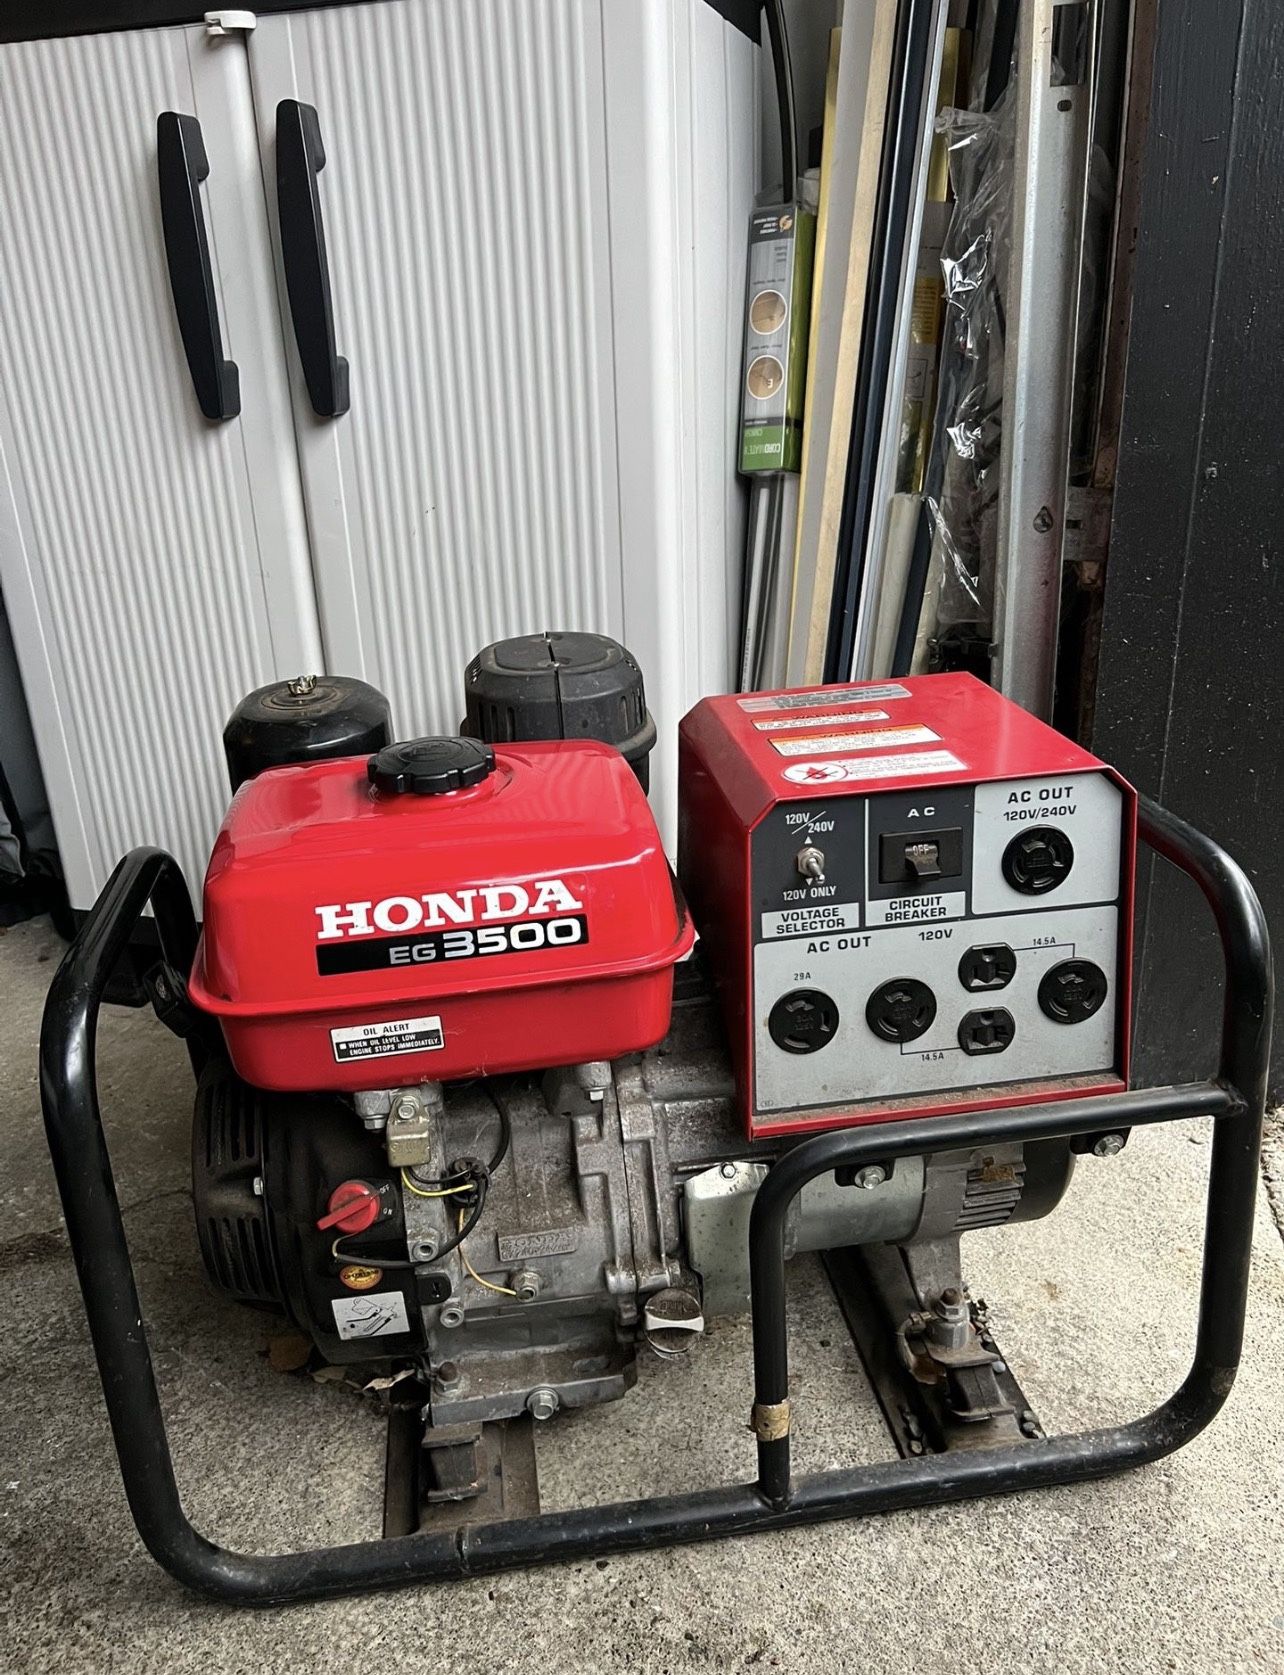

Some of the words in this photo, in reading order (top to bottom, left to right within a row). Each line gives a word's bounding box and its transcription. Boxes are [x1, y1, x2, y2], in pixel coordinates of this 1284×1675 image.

[1007, 791, 1031, 804] AC
[1039, 786, 1074, 801] OUT
[907, 806, 936, 818] AC
[1003, 805, 1077, 821] 120V/240V
[912, 844, 929, 856] OFF
[783, 889, 807, 901] 120V
[810, 885, 837, 898] ONLY
[314, 879, 584, 940] HONDA
[889, 896, 943, 911] CIRCUIT
[781, 907, 840, 922] VOLTAGE
[885, 907, 946, 922] BREAKER
[776, 918, 845, 935] SELECTOR
[388, 942, 436, 965] EG
[442, 917, 582, 958] 3500
[918, 929, 953, 941] 120V
[1033, 936, 1056, 946] 14.5A
[806, 940, 830, 954] AC
[838, 936, 872, 950] OUT
[794, 972, 811, 981] 29A
[363, 1027, 377, 1036] OIL
[382, 1023, 410, 1034] ALERT
[348, 1040, 368, 1049] WHEN
[369, 1038, 380, 1046] OIL
[381, 1036, 400, 1044] LEVEL
[401, 1034, 416, 1042] LOW
[349, 1046, 373, 1056] ENGINE
[374, 1043, 396, 1053] STOPS
[397, 1038, 440, 1049] IMMEDIATELY.
[921, 1052, 945, 1062] 14.5A
[379, 1184, 390, 1194] OFF
